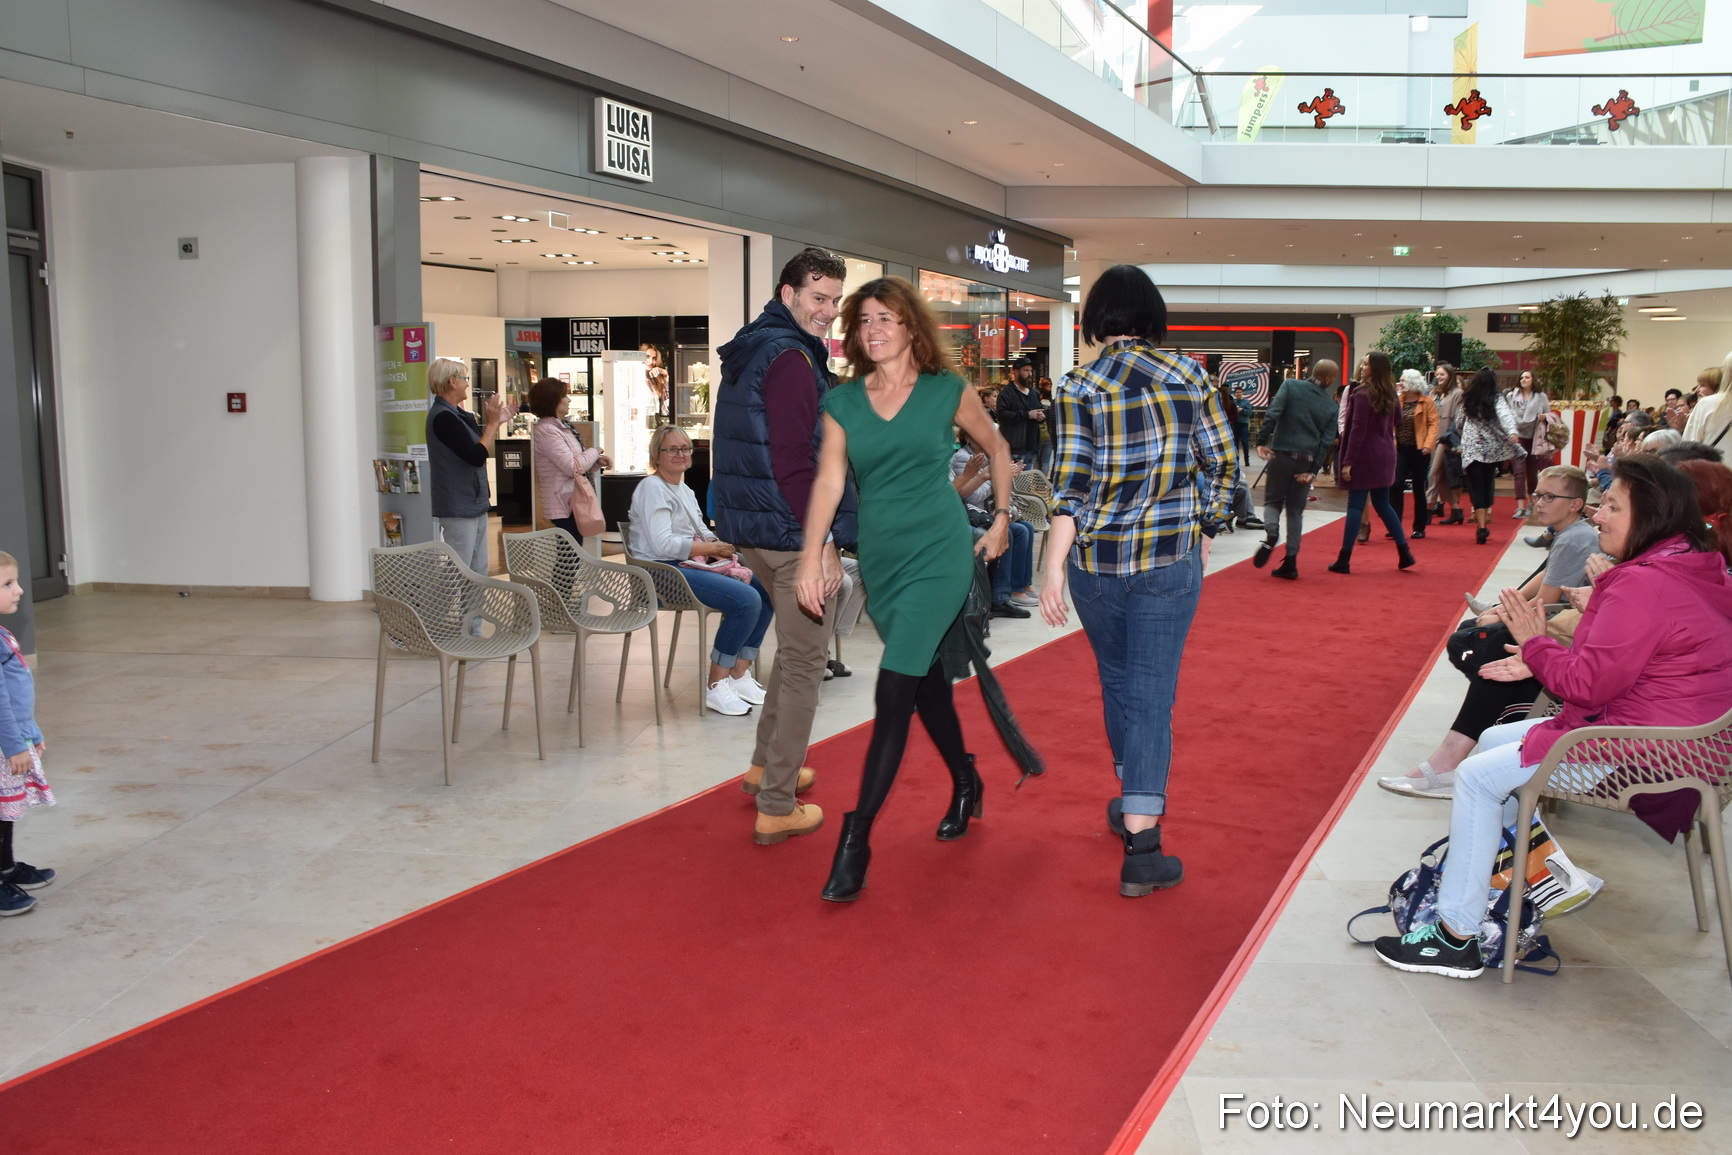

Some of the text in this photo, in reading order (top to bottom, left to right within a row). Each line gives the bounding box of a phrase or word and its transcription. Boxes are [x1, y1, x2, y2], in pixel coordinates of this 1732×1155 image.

[607, 103, 650, 142] LUISA
[1241, 93, 1268, 138] jumpers
[607, 139, 651, 177] LUISA
[573, 321, 606, 336] LUISA
[573, 339, 606, 354] LUISA
